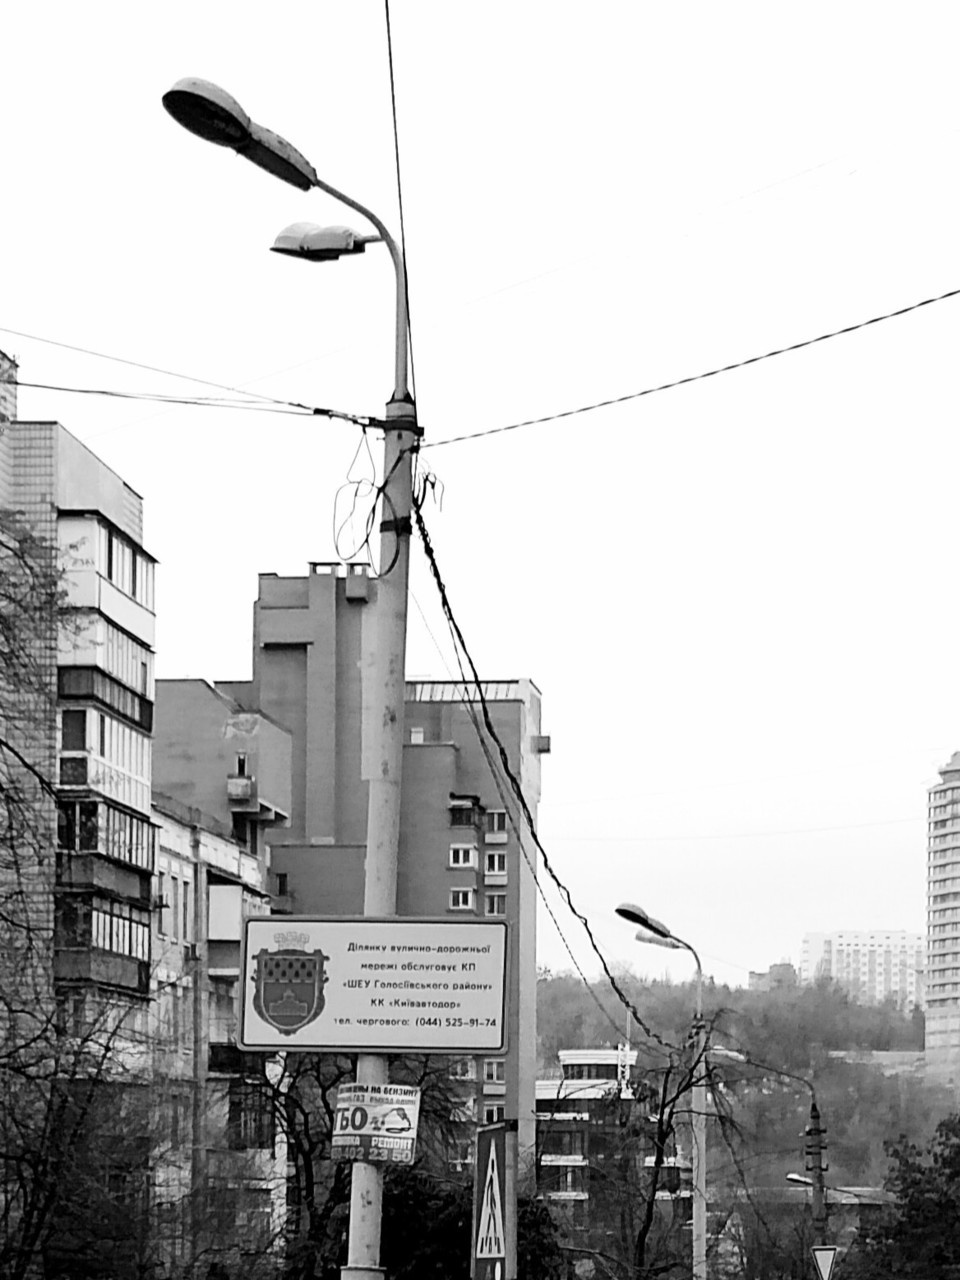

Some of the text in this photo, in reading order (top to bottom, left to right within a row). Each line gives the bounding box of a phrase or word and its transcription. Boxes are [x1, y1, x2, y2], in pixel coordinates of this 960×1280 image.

[347, 942, 491, 954] Ділянку вулично-дорожньої
[361, 962, 476, 973] мережі обслуговує КП
[343, 979, 493, 992] «ШЕУ Голосіївського району»
[370, 998, 461, 1010] КК «Київавтодор»
[334, 1017, 497, 1028] тел. чергового: (044) 525-91-74
